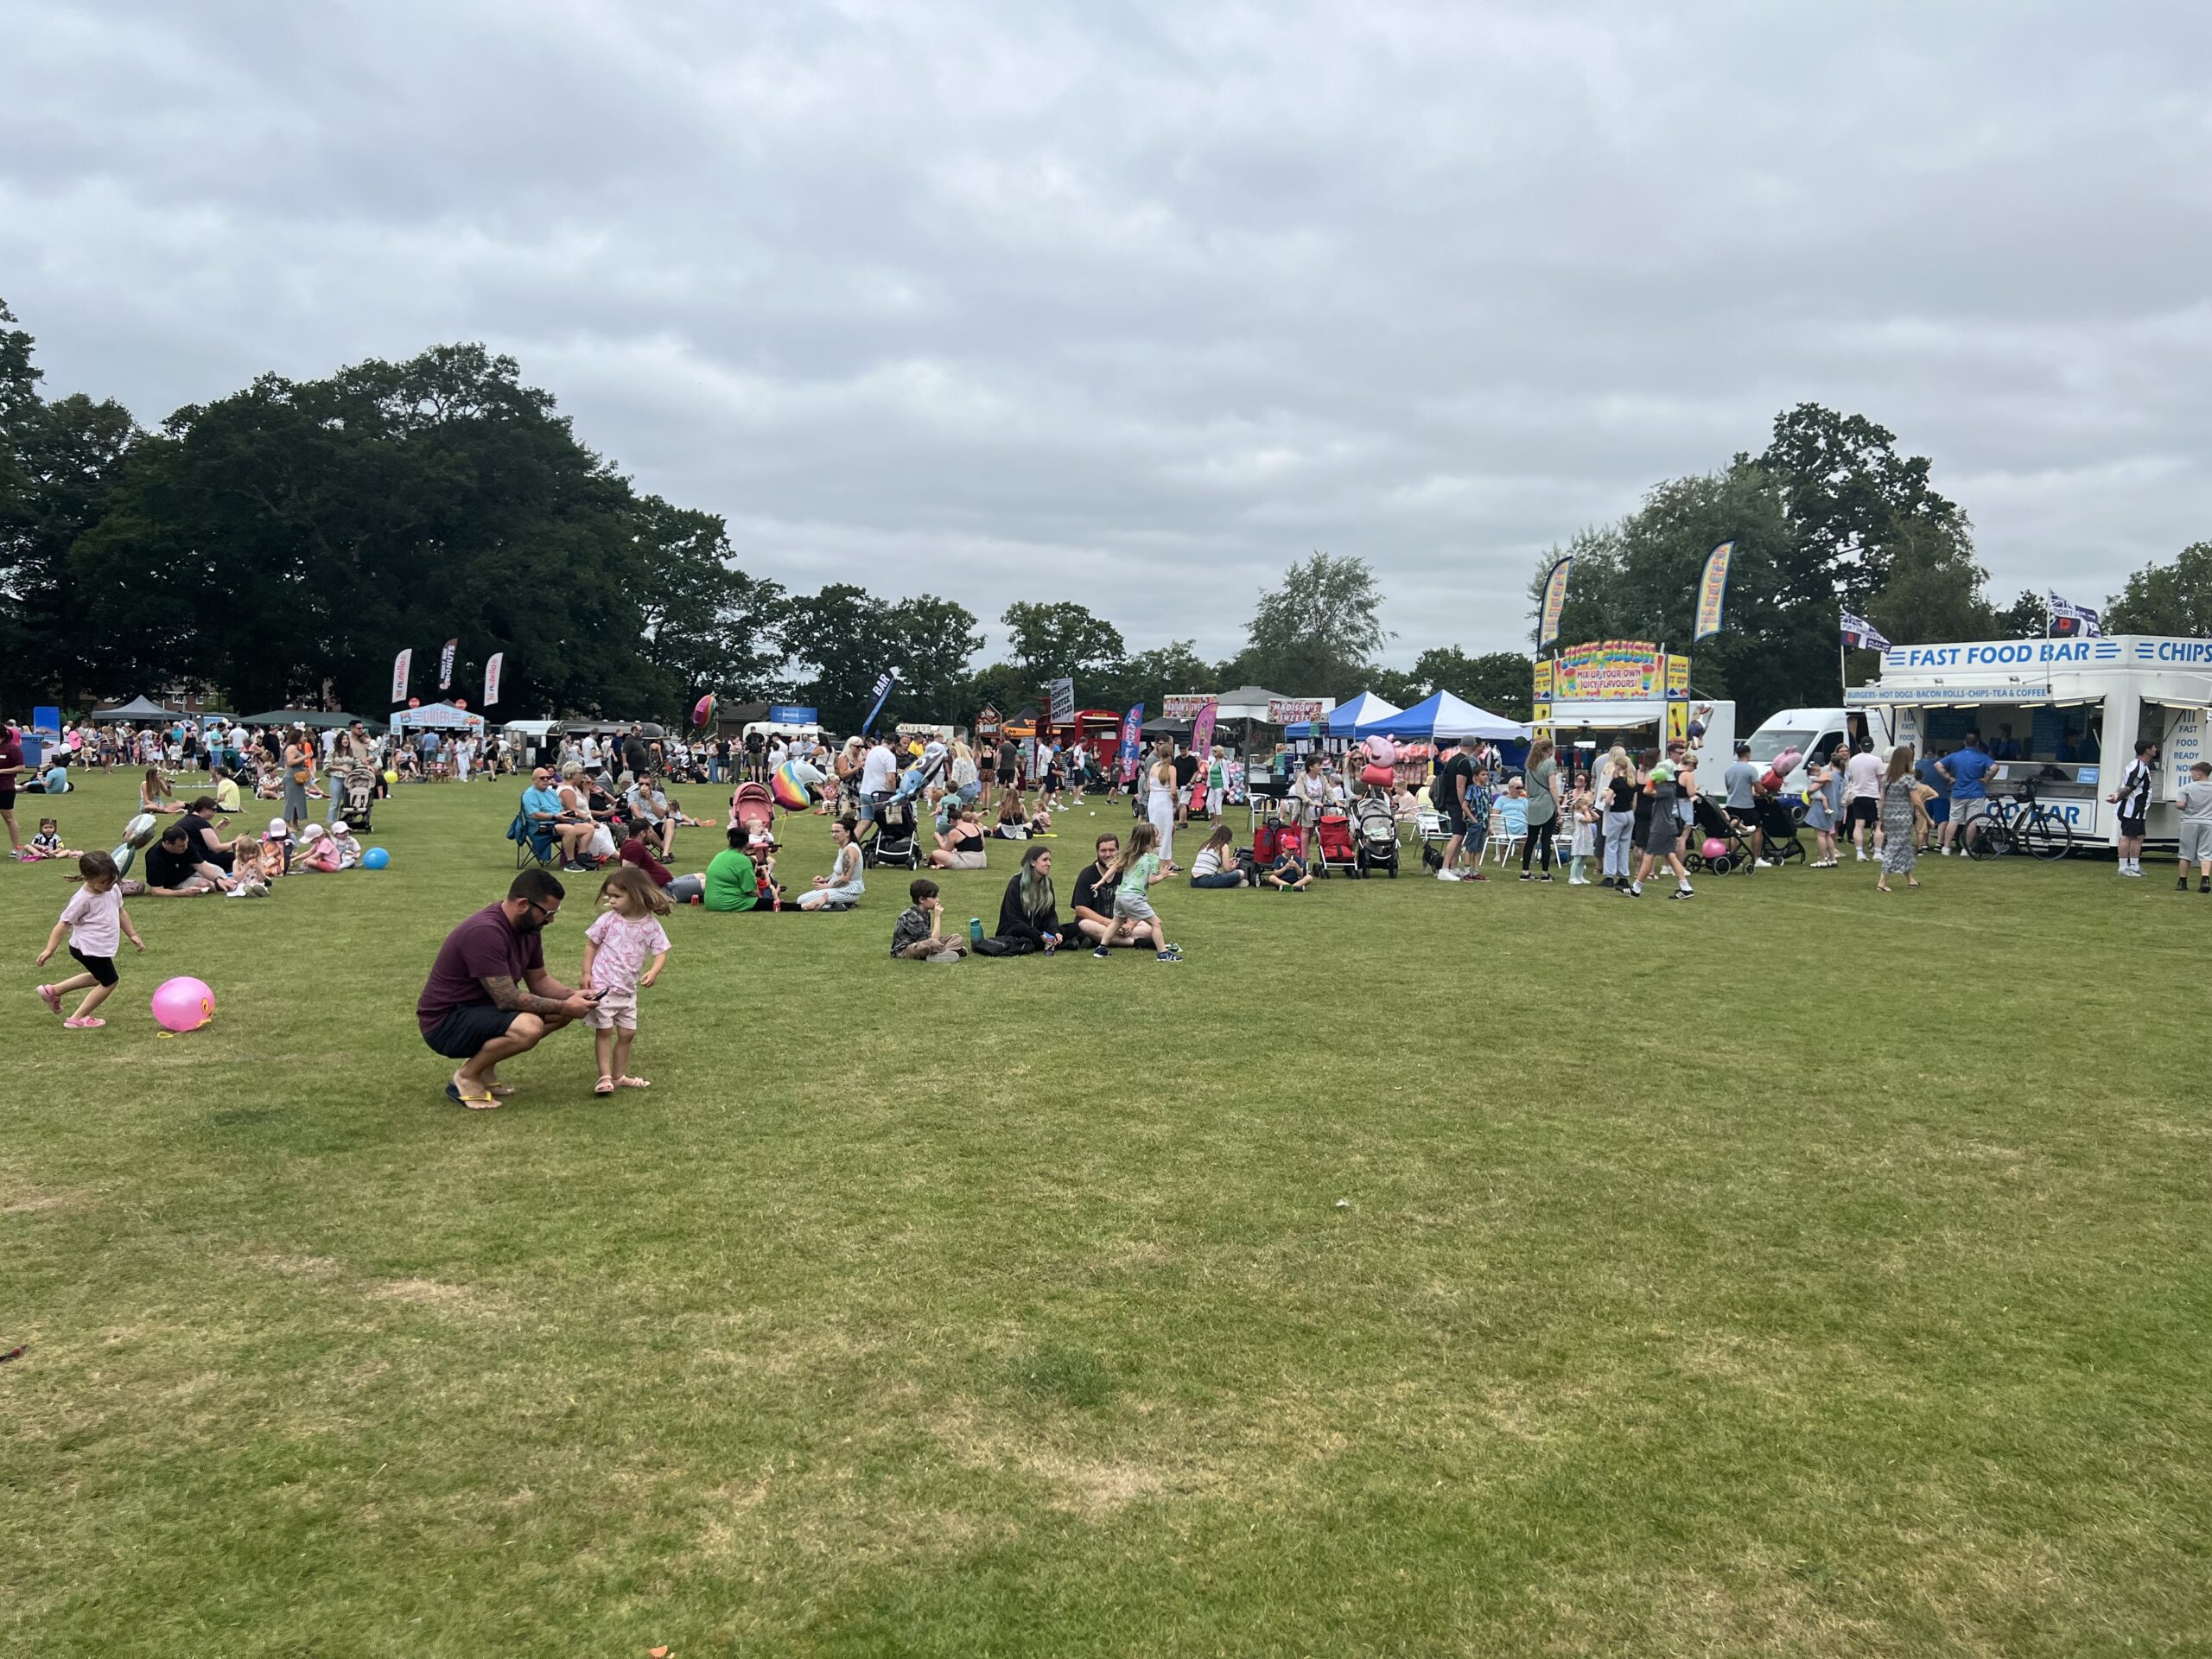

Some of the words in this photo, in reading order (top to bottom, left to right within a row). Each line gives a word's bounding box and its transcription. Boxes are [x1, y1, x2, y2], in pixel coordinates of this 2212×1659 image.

[444, 645, 455, 681] DONUTS
[1561, 642, 1599, 670] JUST
[1603, 640, 1656, 664] SLUSH
[1910, 649, 1961, 666] FAST
[1967, 645, 2033, 664] FOOD
[2039, 643, 2090, 662] BAR
[2158, 642, 2212, 663] CHIPS
[873, 673, 890, 696] BAR
[1602, 670, 1621, 678] YOUR
[1580, 681, 1598, 690] JUICY
[423, 710, 449, 724] DINER
[1274, 703, 1318, 713] MADISON'S
[1279, 714, 1310, 722] SWEETS
[1126, 710, 1140, 747] CANDY
